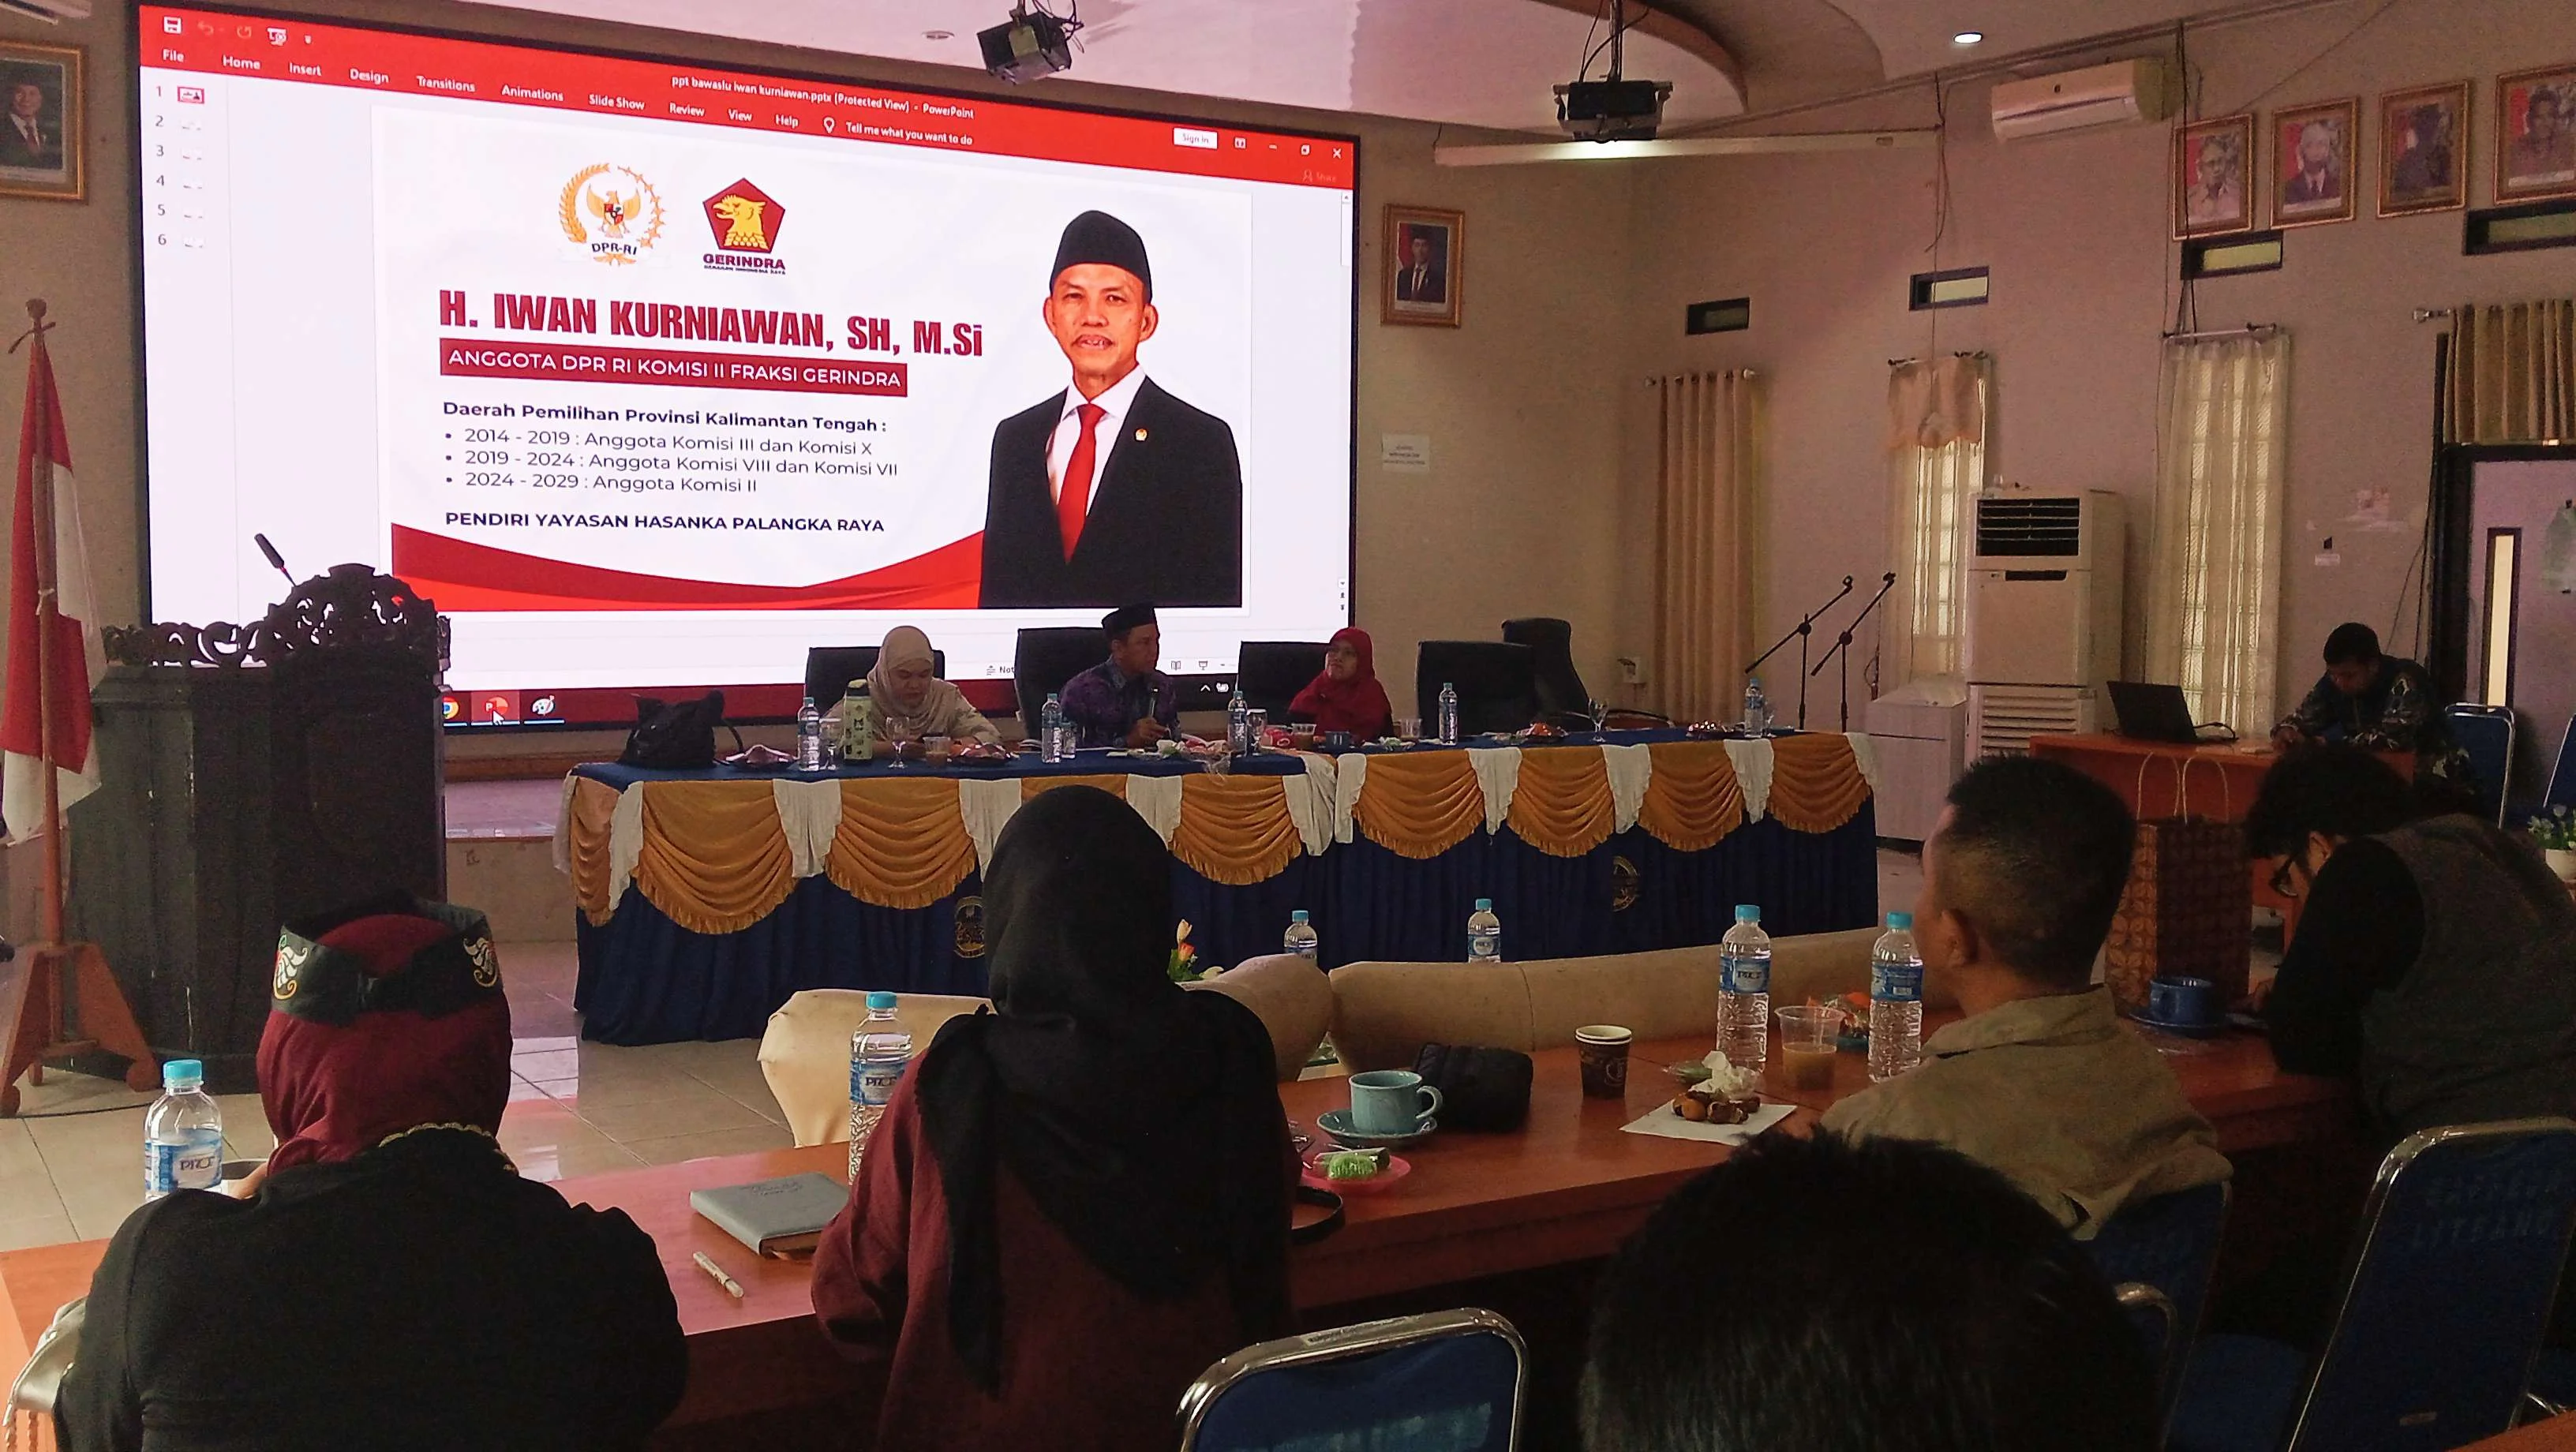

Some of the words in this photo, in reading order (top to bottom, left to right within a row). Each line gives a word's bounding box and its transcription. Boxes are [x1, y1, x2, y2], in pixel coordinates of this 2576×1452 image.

[163, 50, 184, 63] File
[223, 55, 260, 69] Home
[289, 63, 321, 77] Insert
[350, 69, 389, 84] Design
[156, 86, 162, 97] 1
[417, 76, 475, 92] Transitions
[502, 85, 564, 101] Animations
[672, 77, 689, 88] ppt
[691, 77, 732, 92] bawaslu
[923, 103, 975, 119] PowerPoint
[589, 94, 614, 107] Slide
[616, 96, 645, 110] Show
[670, 103, 705, 117] Review
[728, 109, 752, 122] View
[155, 116, 164, 127] 2
[776, 114, 799, 129] Help
[846, 122, 862, 134] Tell
[864, 126, 878, 136] me
[880, 126, 904, 138] what
[904, 129, 923, 142] you
[924, 130, 947, 142] want
[949, 133, 959, 143] to
[960, 133, 973, 145] do
[1183, 133, 1200, 144] Sign
[155, 145, 164, 157] 3
[156, 175, 165, 186] 4
[158, 204, 166, 216] 5
[158, 234, 167, 245] 6
[592, 241, 637, 255] DPR-RI
[703, 253, 786, 270] GERINDRA
[440, 290, 477, 327] H.
[494, 293, 597, 334] IWAN
[610, 300, 833, 352] KURNIAWAN,
[848, 316, 900, 355] SH,
[914, 320, 983, 357] M.Si
[448, 350, 556, 370] ANGGOTA
[563, 355, 606, 372] DPR
[612, 357, 631, 373] RI
[638, 358, 708, 377] KOMISI
[714, 362, 724, 378] II
[731, 364, 797, 382] FRAKSI
[803, 367, 901, 387] GERINDRA
[444, 402, 515, 417] Daerah
[522, 405, 620, 422] Pemilihan
[625, 409, 699, 425] Provinsi
[706, 411, 807, 429] Kalimantan
[813, 417, 878, 433] Tengah
[465, 428, 510, 443] 2014
[528, 430, 570, 445] 2019
[585, 432, 666, 451] Anggota
[672, 435, 733, 451] Komisi
[739, 437, 754, 451] III
[760, 439, 793, 453] dan
[799, 440, 856, 455] Komisi
[862, 442, 872, 455] X
[465, 451, 509, 465] 2019
[527, 452, 575, 467] 2024
[589, 454, 670, 472] Anggota
[677, 457, 737, 472] Komisi
[743, 458, 770, 473] VIII
[777, 460, 809, 474] dan
[814, 462, 871, 476] Komisi
[877, 464, 897, 477] VII
[466, 473, 514, 487] 2024
[532, 474, 578, 488] 2029
[593, 476, 674, 493] Anggota
[681, 478, 741, 492] Komisi
[748, 480, 756, 492] II
[445, 512, 530, 527] PENDIRI
[536, 514, 628, 529] YAYASAN
[635, 515, 727, 530] HASANKA
[733, 517, 832, 531] PALANGKA
[837, 519, 885, 532] RAYA
